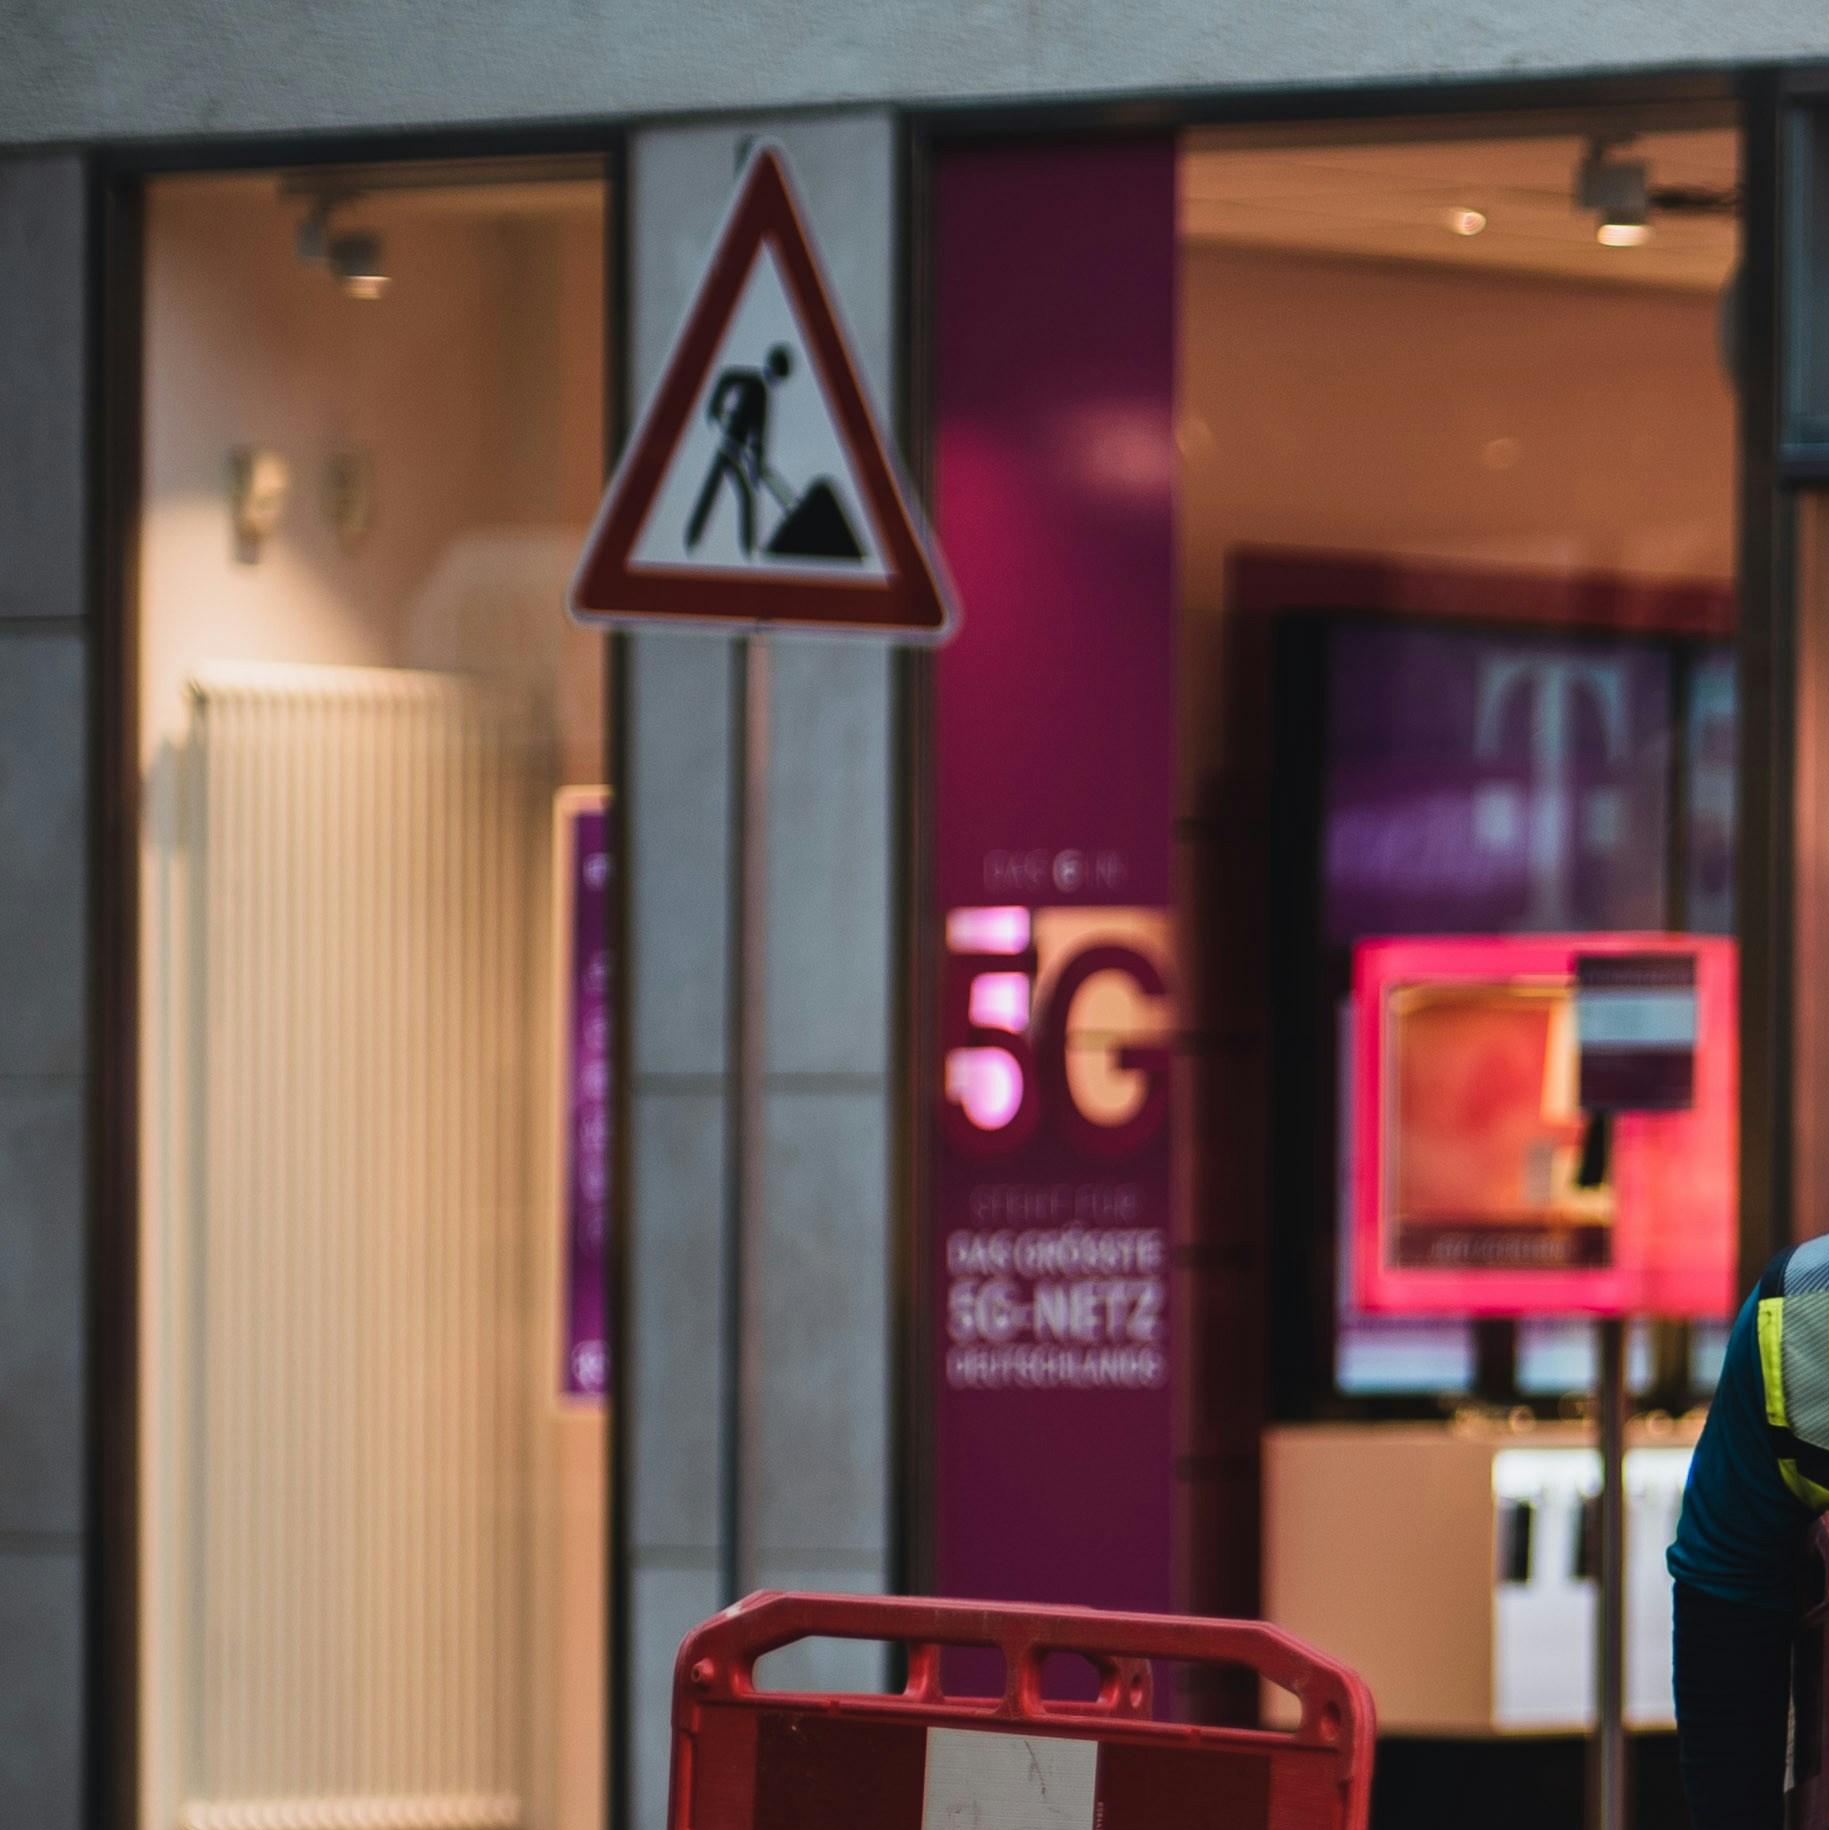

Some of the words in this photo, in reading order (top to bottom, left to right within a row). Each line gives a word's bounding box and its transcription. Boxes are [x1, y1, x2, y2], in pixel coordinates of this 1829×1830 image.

[946, 1230, 1014, 1276] DAS
[1016, 1222, 1163, 1277] GRÖSSTE
[947, 1278, 1165, 1343] 5G-NETZ
